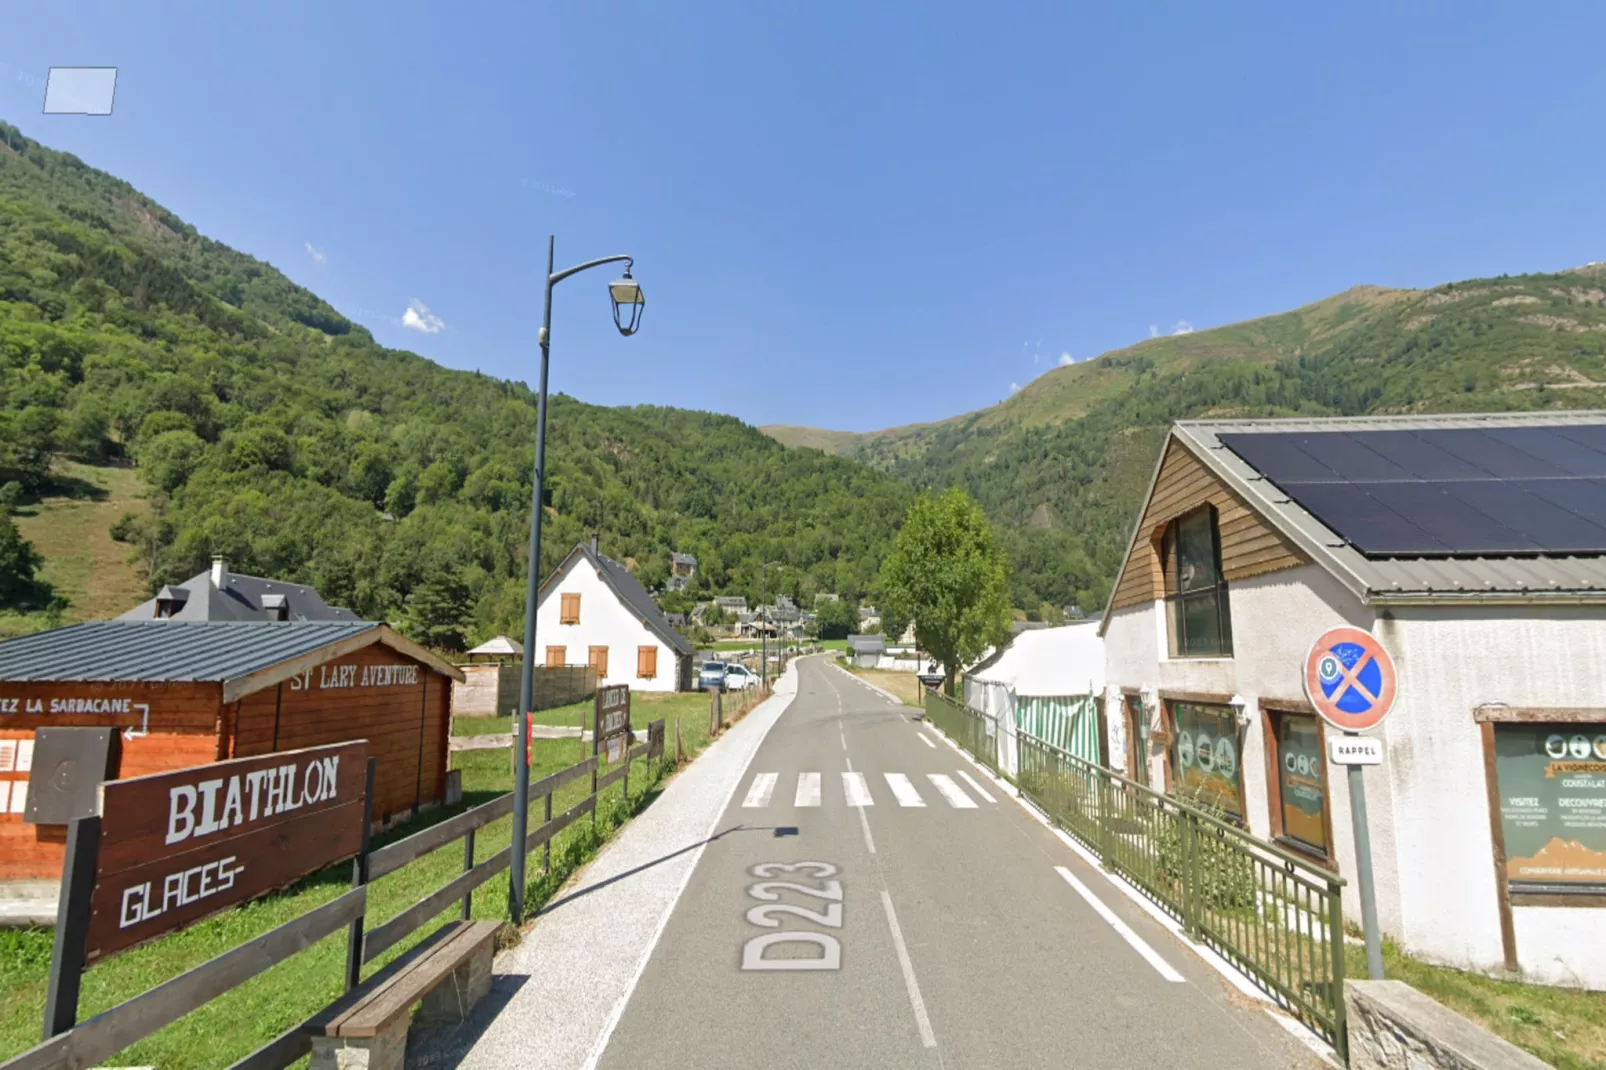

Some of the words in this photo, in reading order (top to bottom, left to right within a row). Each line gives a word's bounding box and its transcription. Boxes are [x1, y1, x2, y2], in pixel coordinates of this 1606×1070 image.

[291, 668, 313, 690] ST
[320, 665, 357, 689] LARY
[360, 664, 419, 687] AVENTURE
[25, 698, 43, 713] LA
[50, 698, 132, 713] SARBACANE
[1338, 746, 1376, 756] RAPPEL
[165, 755, 339, 845] BIATHLON
